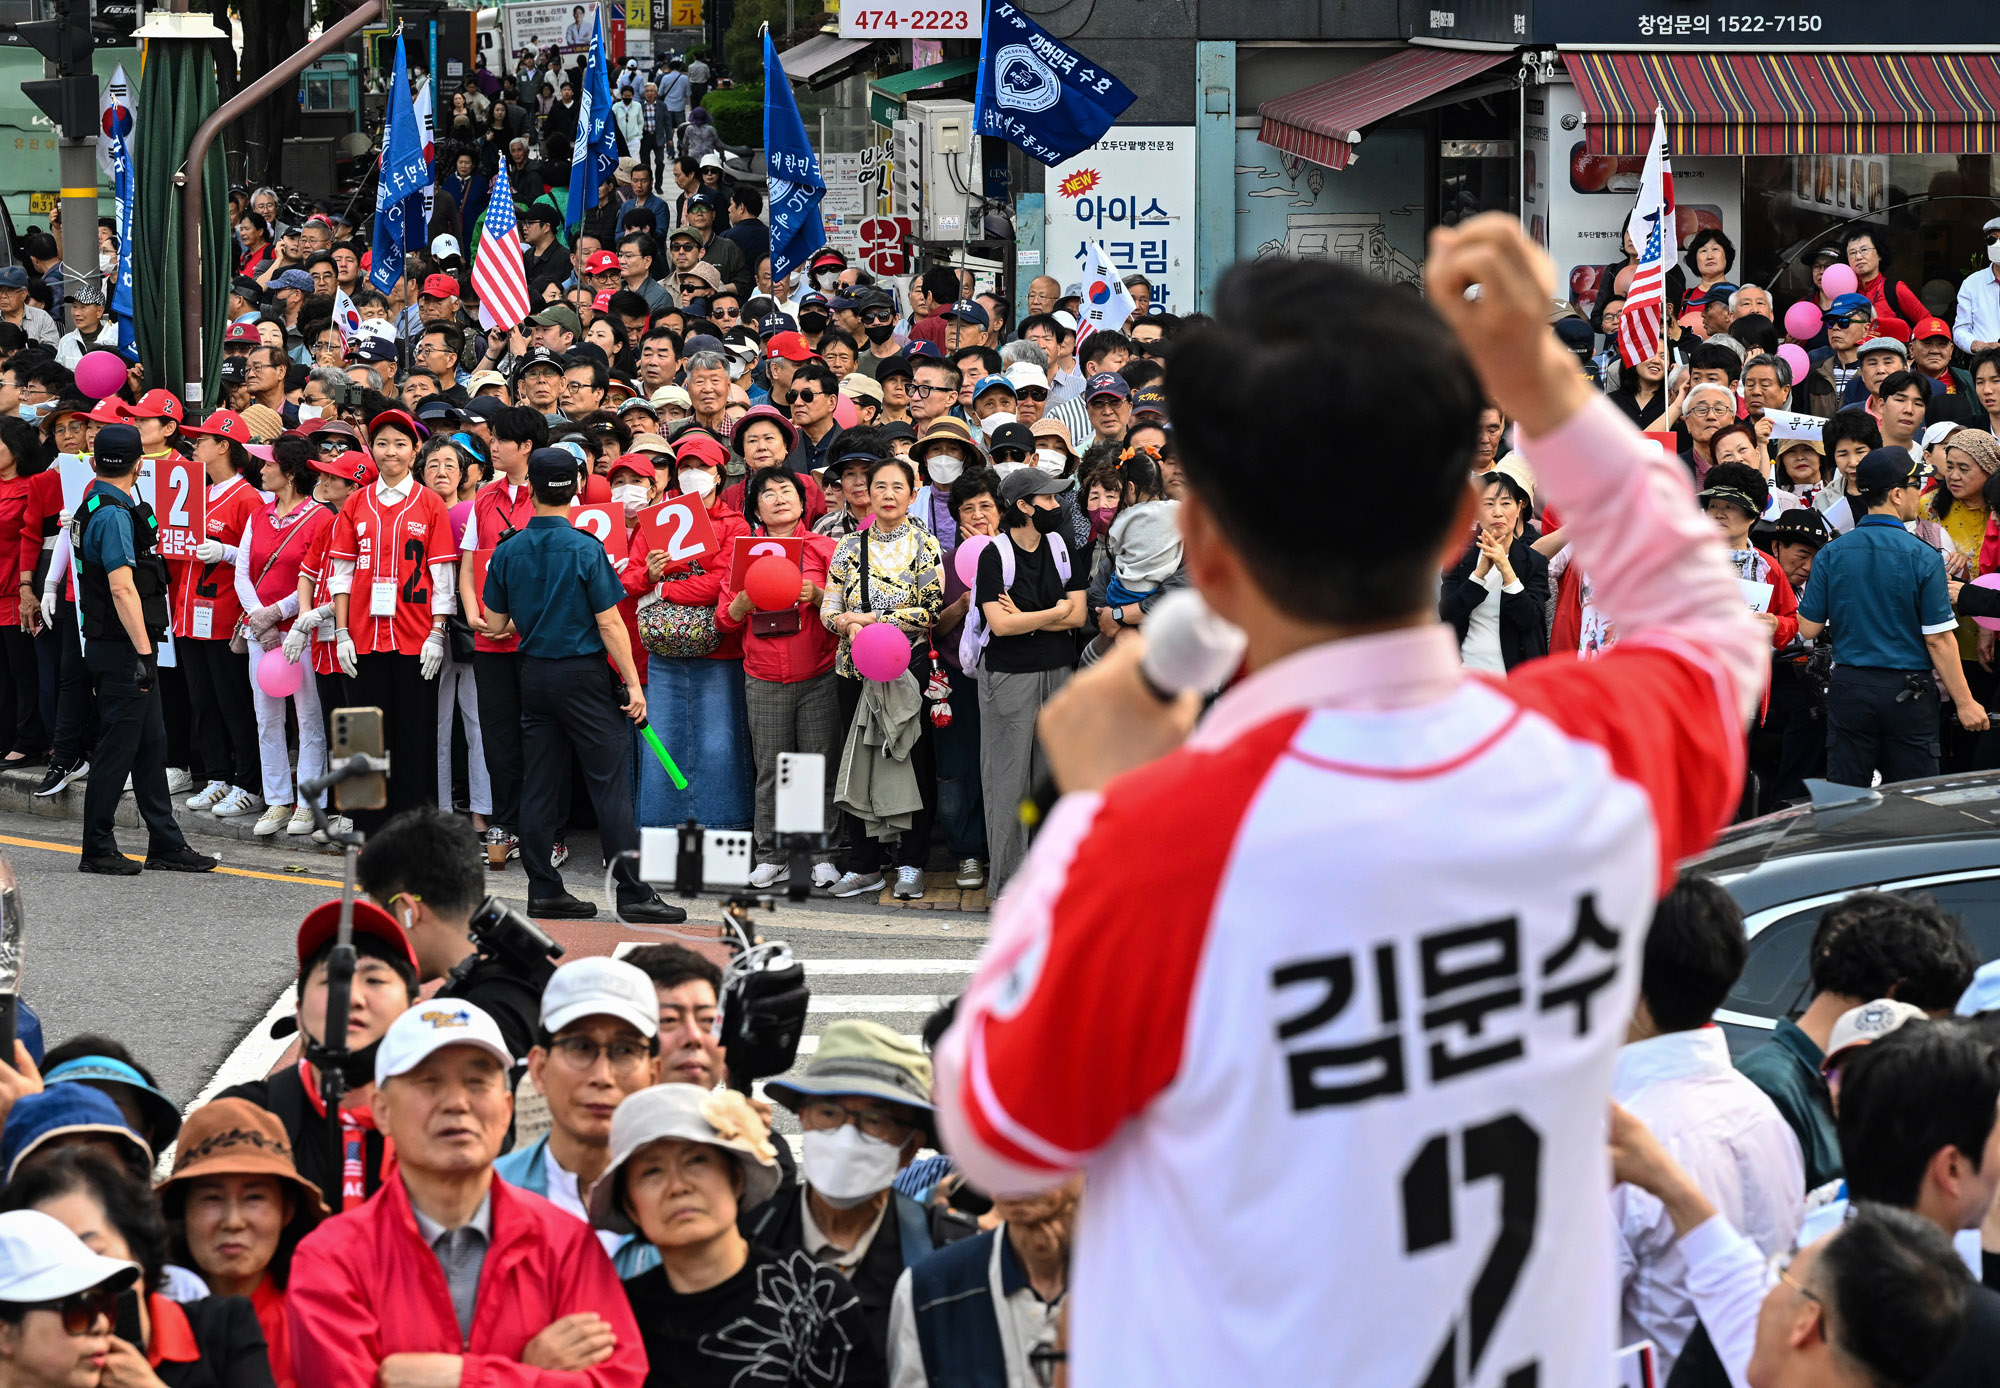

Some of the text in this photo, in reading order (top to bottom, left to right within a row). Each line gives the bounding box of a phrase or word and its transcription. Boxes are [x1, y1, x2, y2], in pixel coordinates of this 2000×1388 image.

[653, 21, 665, 29] 4F
[677, 9, 698, 25] 가
[855, 10, 969, 31] 474-2223
[1638, 15, 1822, 36] 창업문의 1522-7150
[996, 2, 1113, 95] 자유 대한민국 수호
[313, 62, 323, 70] kt
[1009, 71, 1030, 88] ROTC
[1065, 172, 1093, 194] NEW
[1076, 195, 1170, 230] 아이스
[910, 341, 926, 353] J
[163, 398, 175, 415] 2
[220, 418, 233, 434] 2
[353, 464, 366, 481] 2
[169, 465, 189, 527] 2
[207, 523, 224, 533] POWER
[407, 521, 427, 530] PEOPLE
[407, 526, 426, 535] POWER
[656, 503, 706, 561] 2
[162, 529, 198, 556] 김문수
[402, 538, 428, 605] 2
[1270, 891, 1622, 1115] 김문수
[1399, 1109, 1546, 1388] 2
